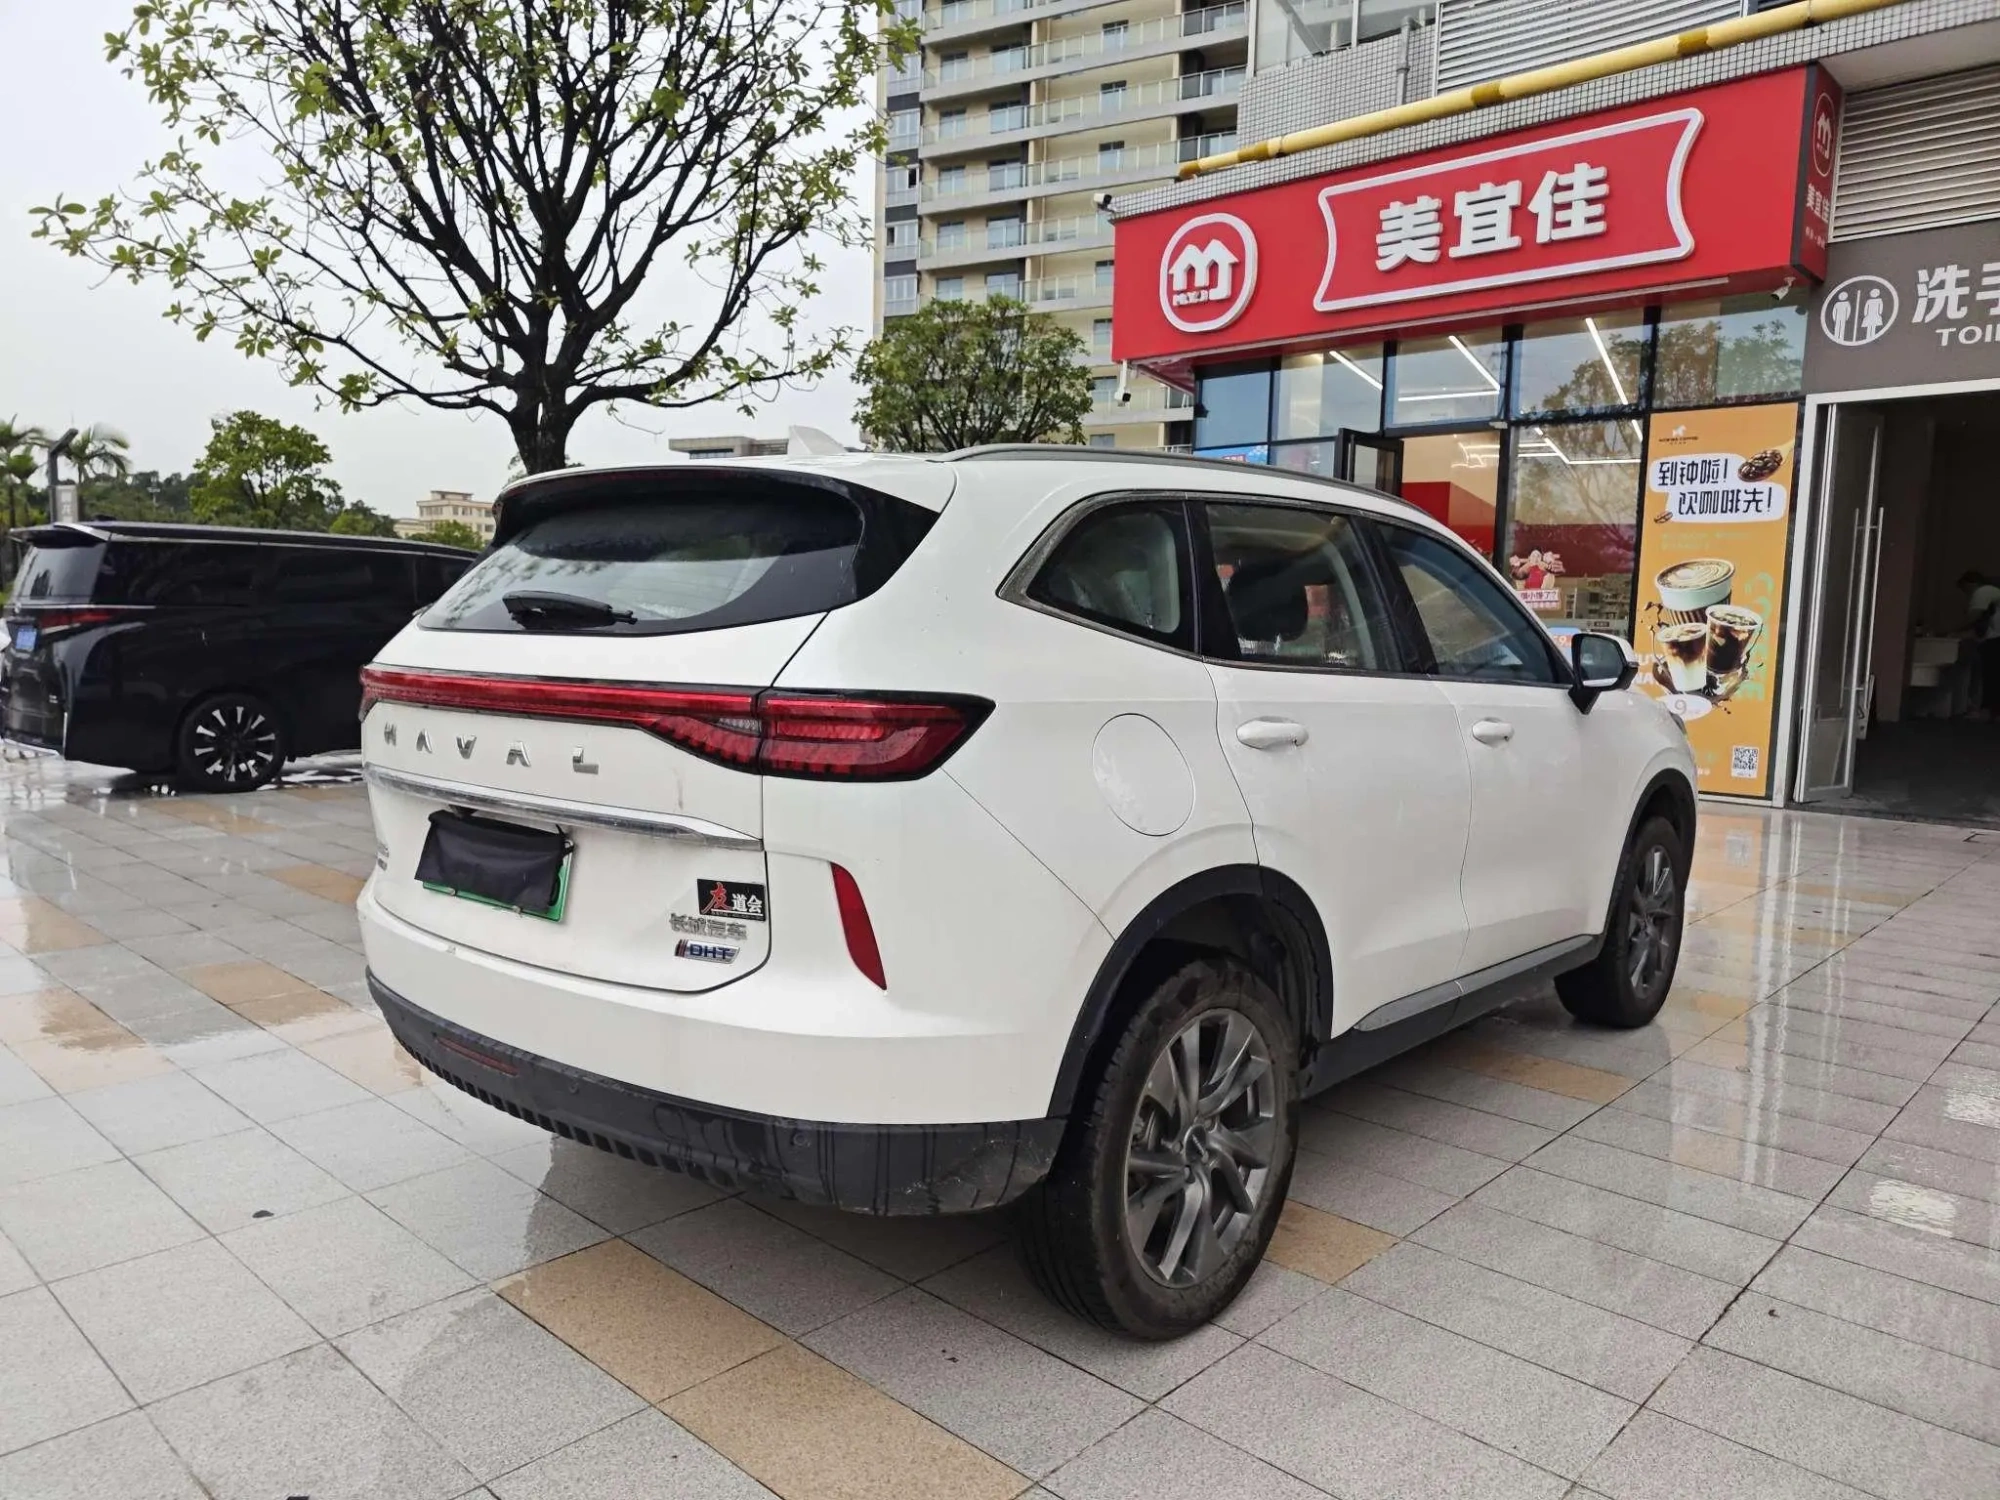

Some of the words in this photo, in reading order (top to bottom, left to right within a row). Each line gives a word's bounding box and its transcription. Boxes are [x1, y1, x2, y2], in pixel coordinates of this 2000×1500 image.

[1375, 162, 1610, 272] 美宜佳
[384, 722, 599, 775] HAVAL
[669, 913, 748, 940] 长城汽车
[689, 943, 731, 960] DHT
